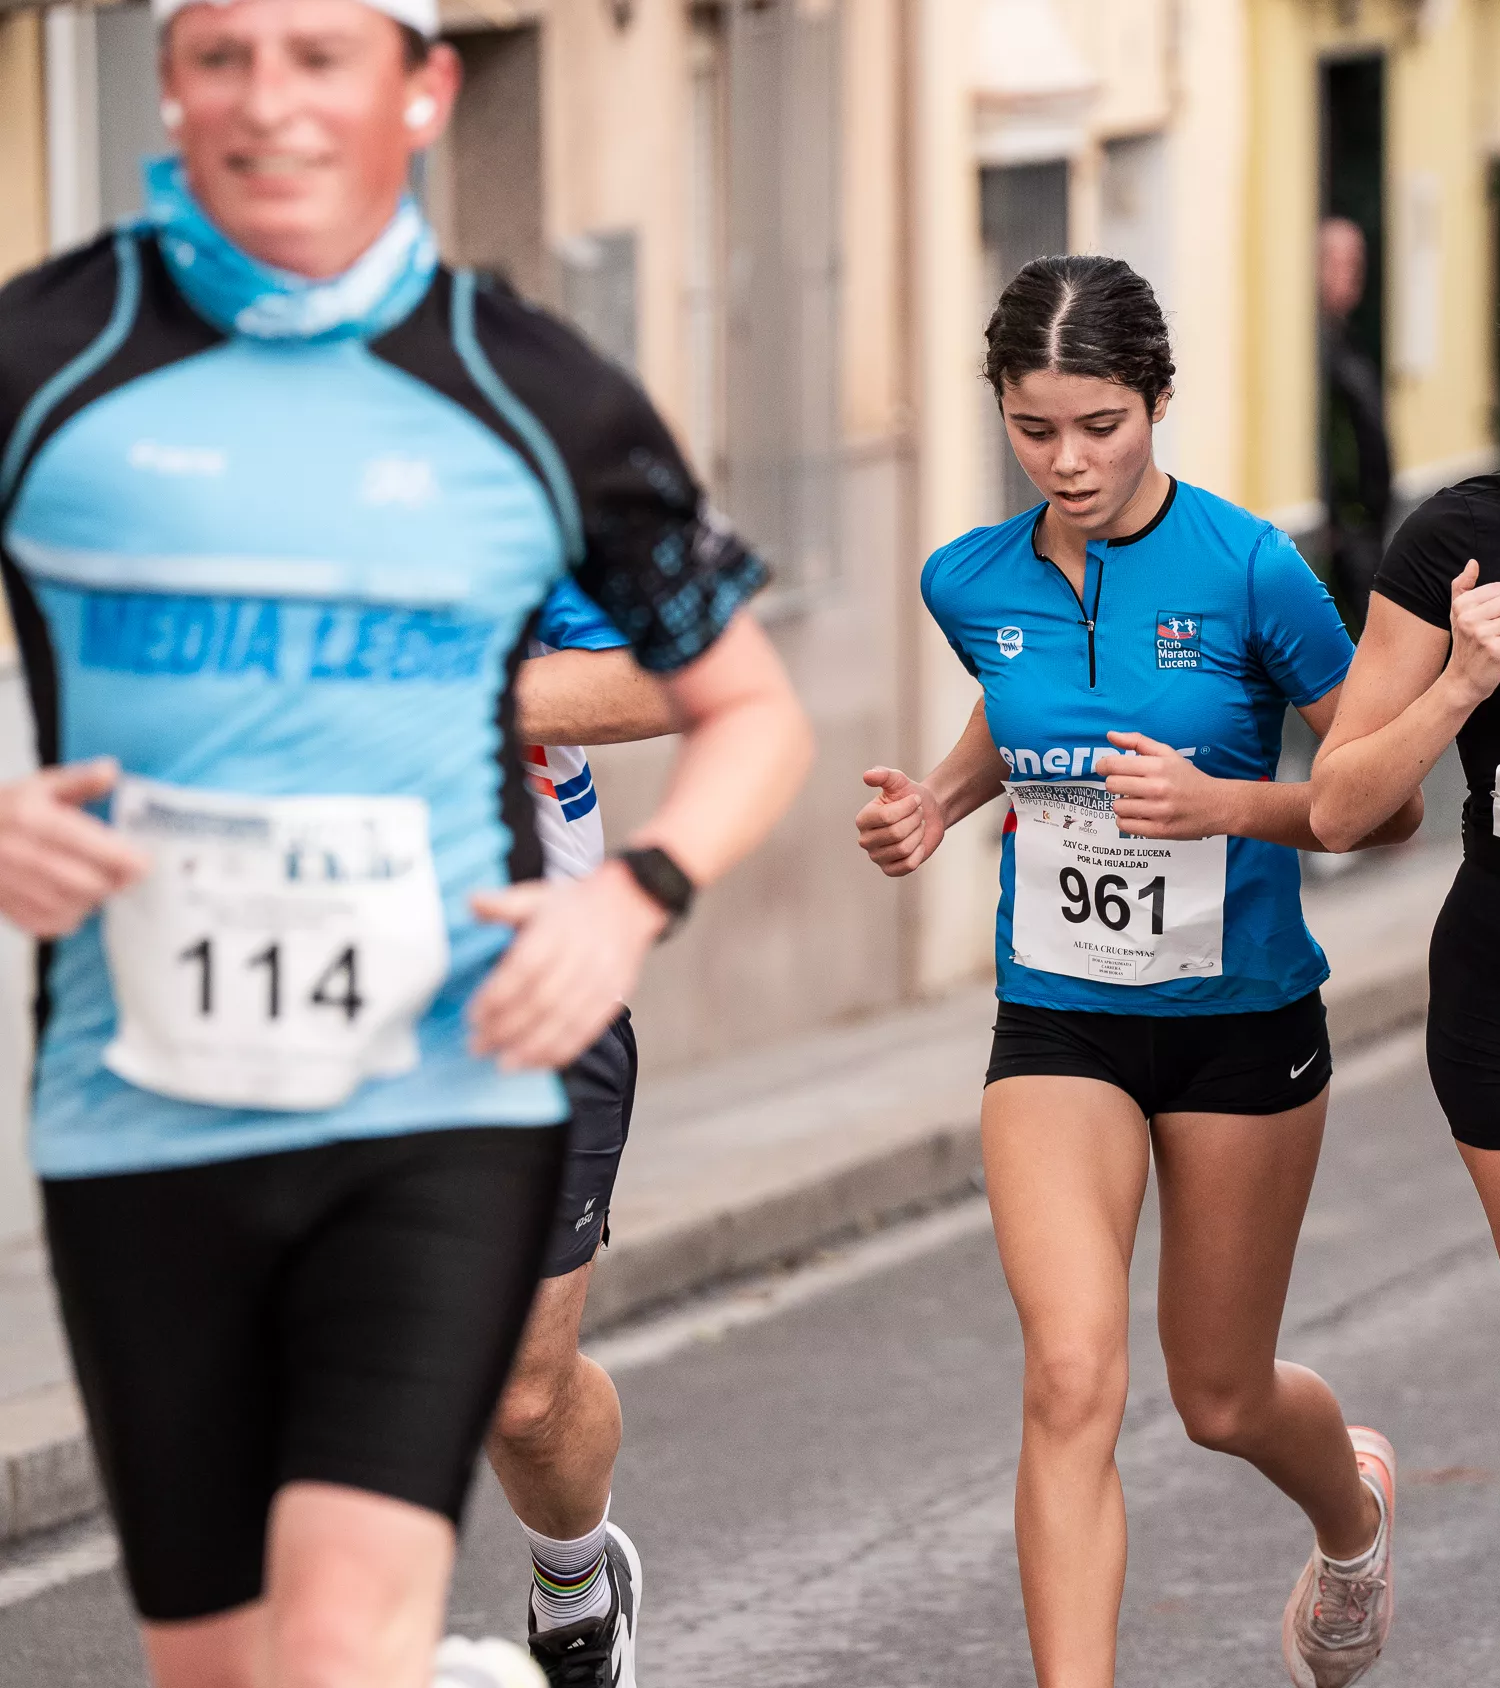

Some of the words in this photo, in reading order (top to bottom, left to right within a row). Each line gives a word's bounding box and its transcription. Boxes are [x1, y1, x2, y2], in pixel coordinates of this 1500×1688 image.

[1156, 639, 1182, 649] Club
[1158, 659, 1197, 669] Lucena
[999, 746, 1197, 777] ener
[1054, 786, 1101, 800] PROVINCIAL
[1068, 794, 1115, 811] POPULARES
[1069, 804, 1077, 814] DE
[1062, 839, 1077, 850] XXV
[1077, 841, 1091, 853] C.P.
[1092, 845, 1122, 857] CIUDAD
[1123, 848, 1136, 857] DE
[1137, 848, 1172, 858] LUCENA
[1077, 854, 1091, 866] POR
[1092, 857, 1103, 867] LA
[1104, 857, 1149, 869] IGUALDAD
[1059, 866, 1166, 936] 961
[1073, 941, 1099, 952] ALTEA
[1100, 944, 1134, 957] CRUCES
[176, 932, 366, 1026] 114
